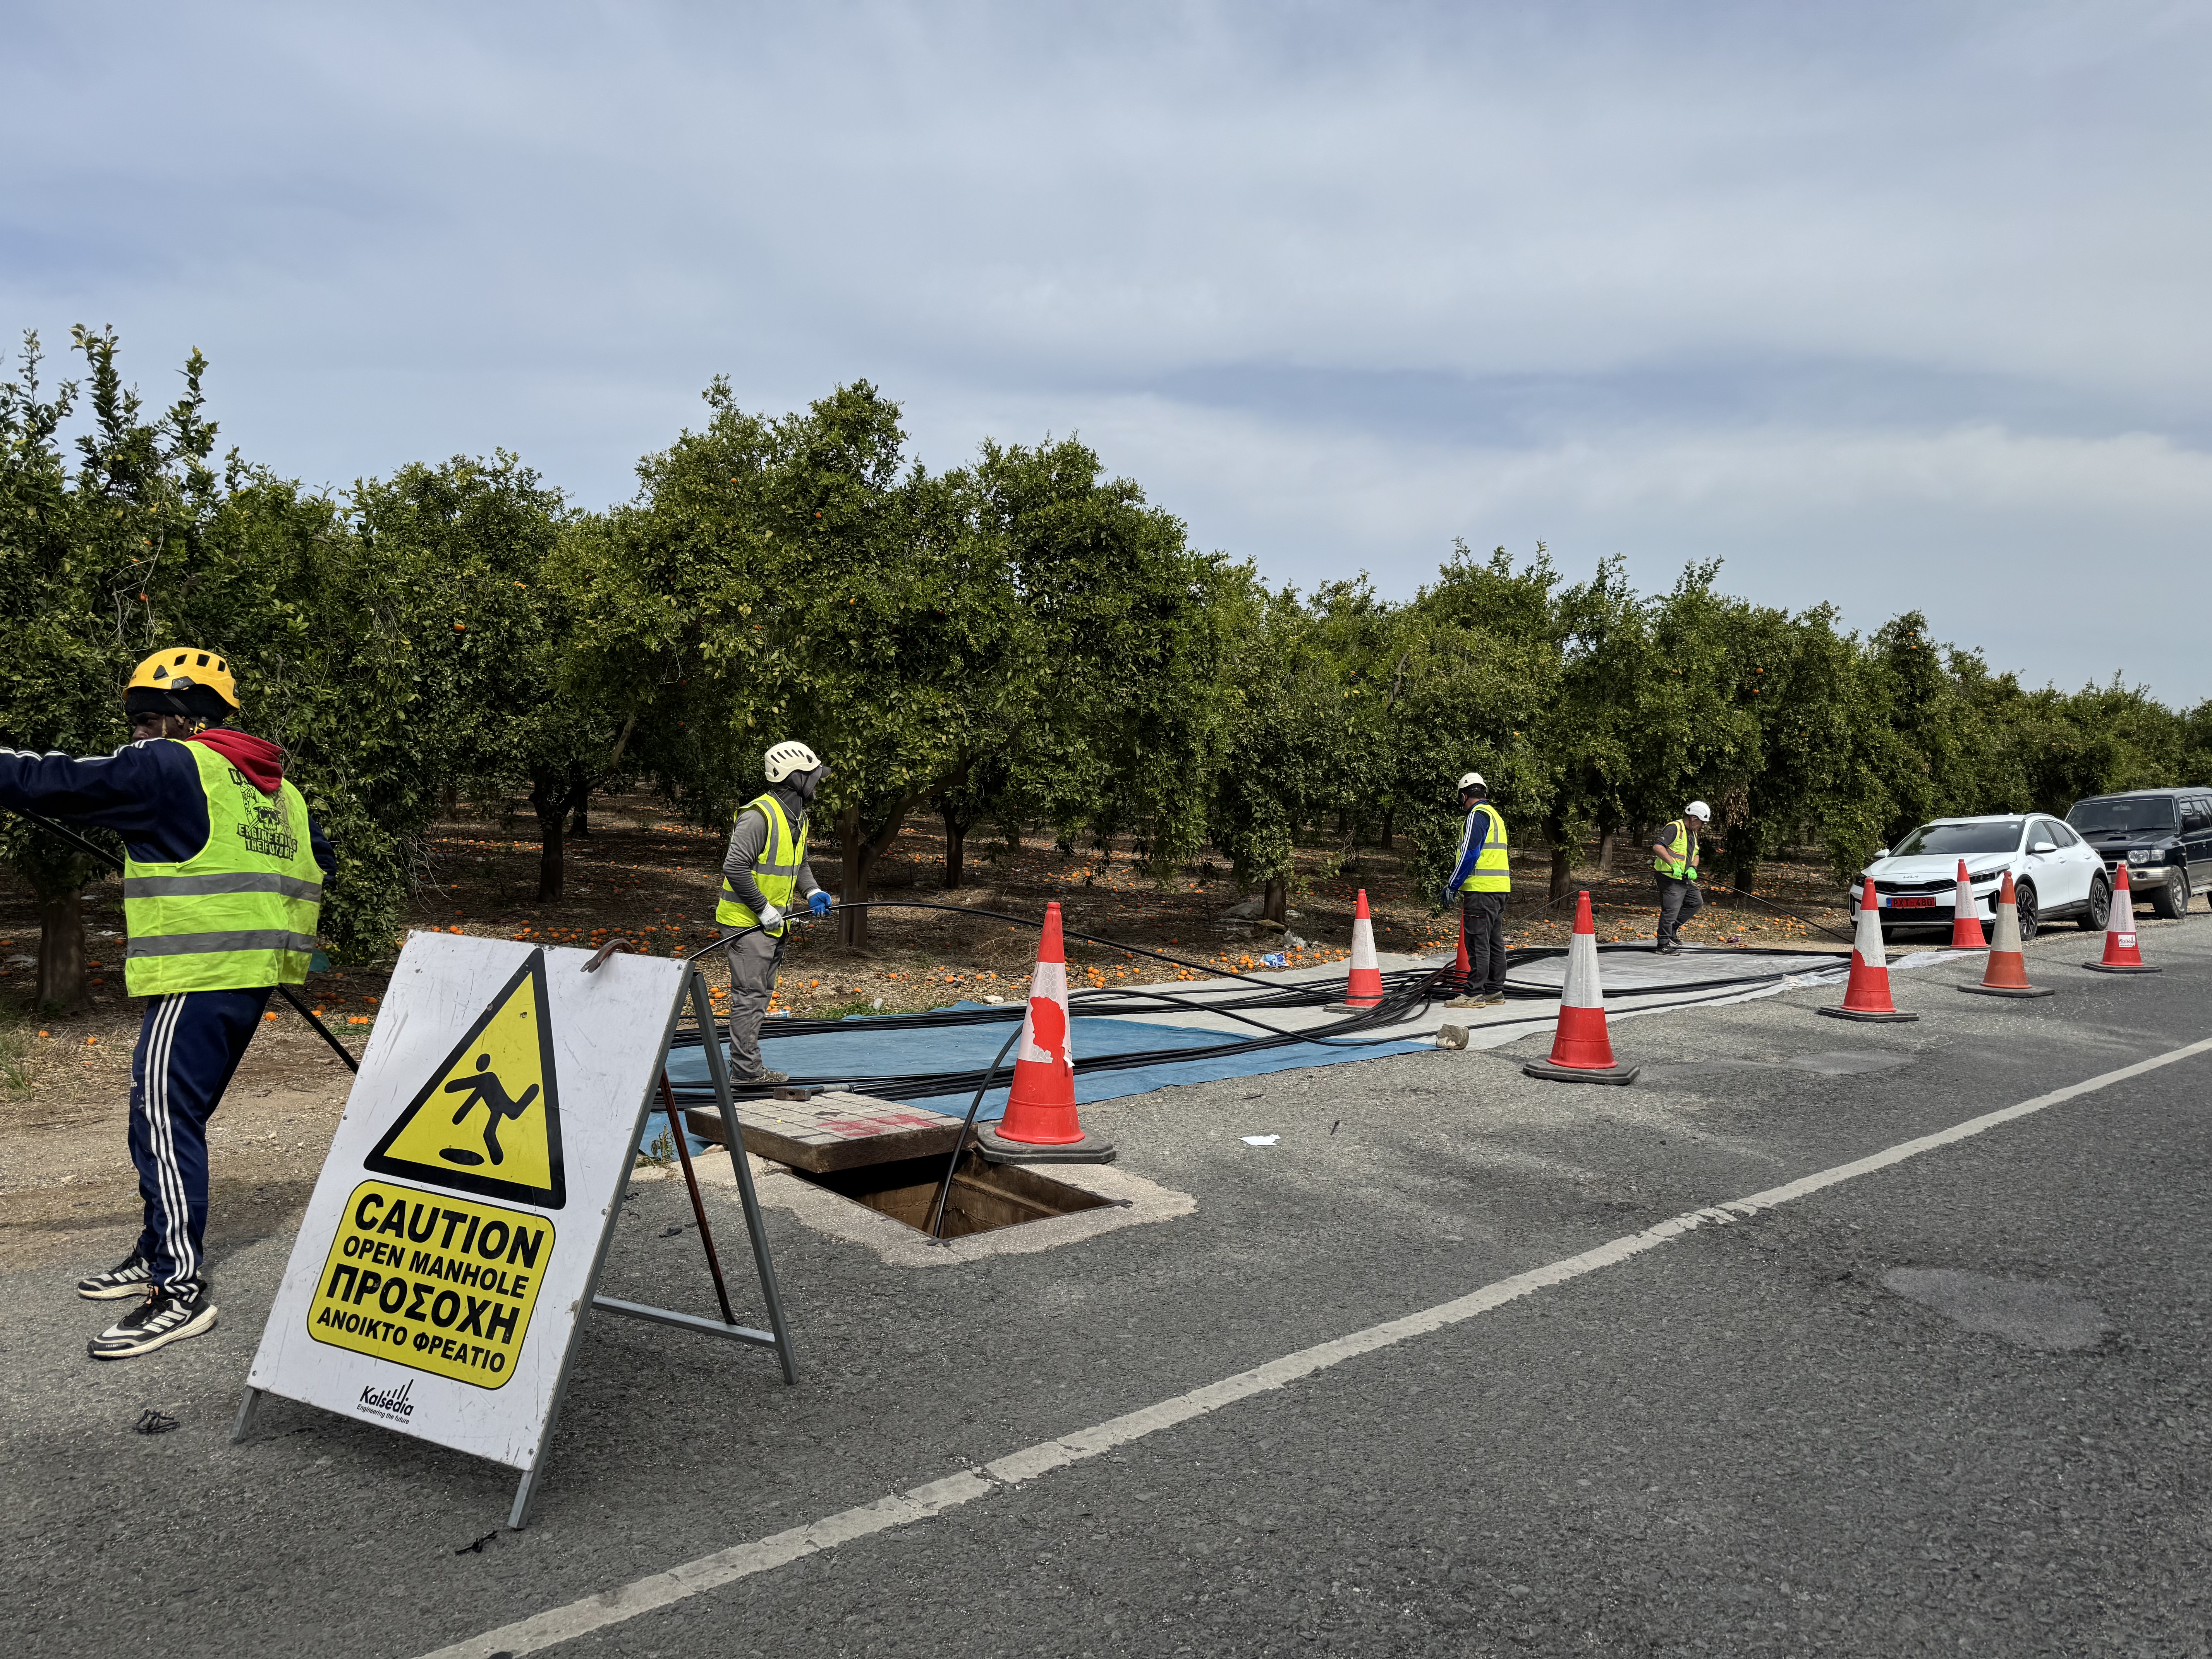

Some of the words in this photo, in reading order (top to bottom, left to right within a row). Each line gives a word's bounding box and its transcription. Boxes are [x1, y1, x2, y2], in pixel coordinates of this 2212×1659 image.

[246, 839, 263, 852] THE
[264, 842, 294, 859] FUTURE
[1893, 898, 1910, 907] PXT
[1916, 898, 1932, 906] 480
[355, 1193, 545, 1269] CAUTION
[343, 1235, 406, 1269] OPEN
[408, 1250, 530, 1299] MANHOLE
[326, 1263, 520, 1345] ΠΡΟΣΟΧΗ
[316, 1307, 408, 1346] ΑΝΟΙΚΤΟ
[413, 1332, 505, 1373] ΦΡΕΑΤΙΟ
[356, 1404, 386, 1419] Engineering
[394, 1415, 409, 1425] future
[359, 1379, 414, 1416] Kalsedia
